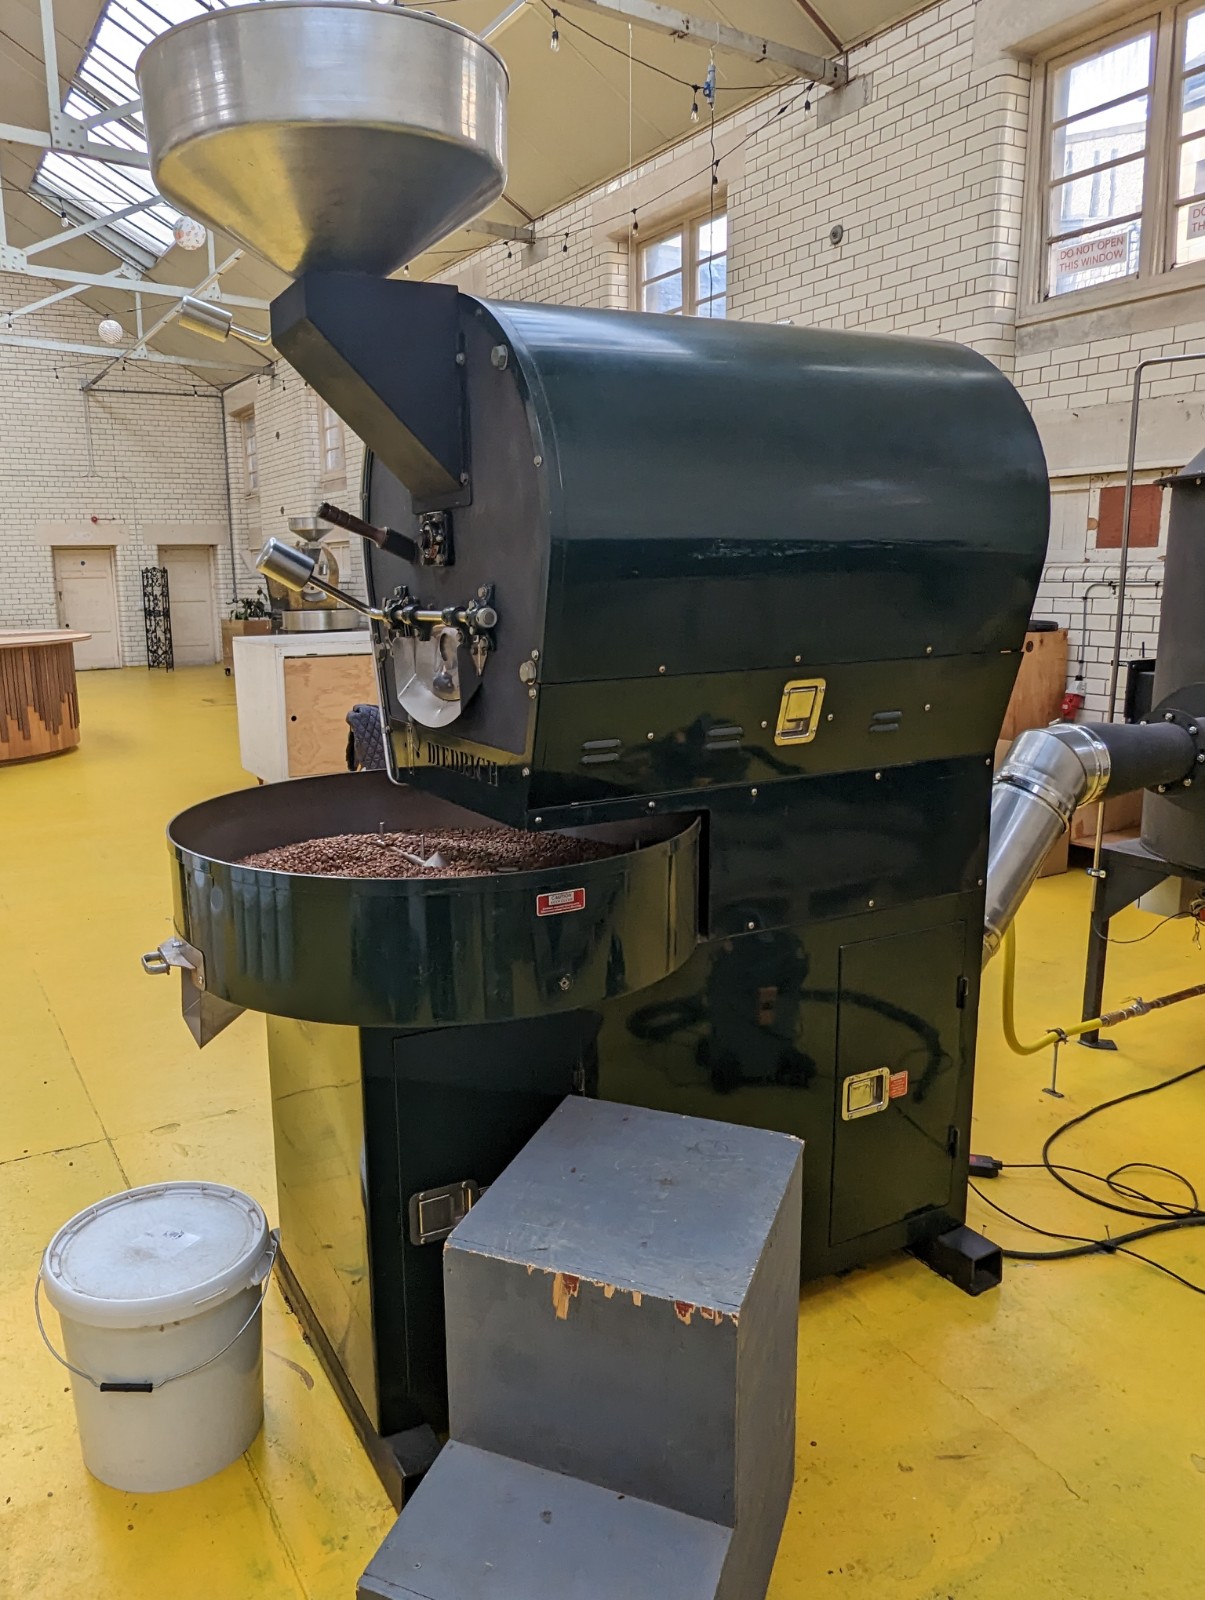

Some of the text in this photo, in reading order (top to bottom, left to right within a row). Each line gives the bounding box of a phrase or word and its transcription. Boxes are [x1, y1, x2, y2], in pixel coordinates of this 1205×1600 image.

[1060, 235, 1124, 260] DO NOT OPEN
[1059, 249, 1124, 272] THIS WINDOW
[427, 741, 498, 787] DIEDRICH
